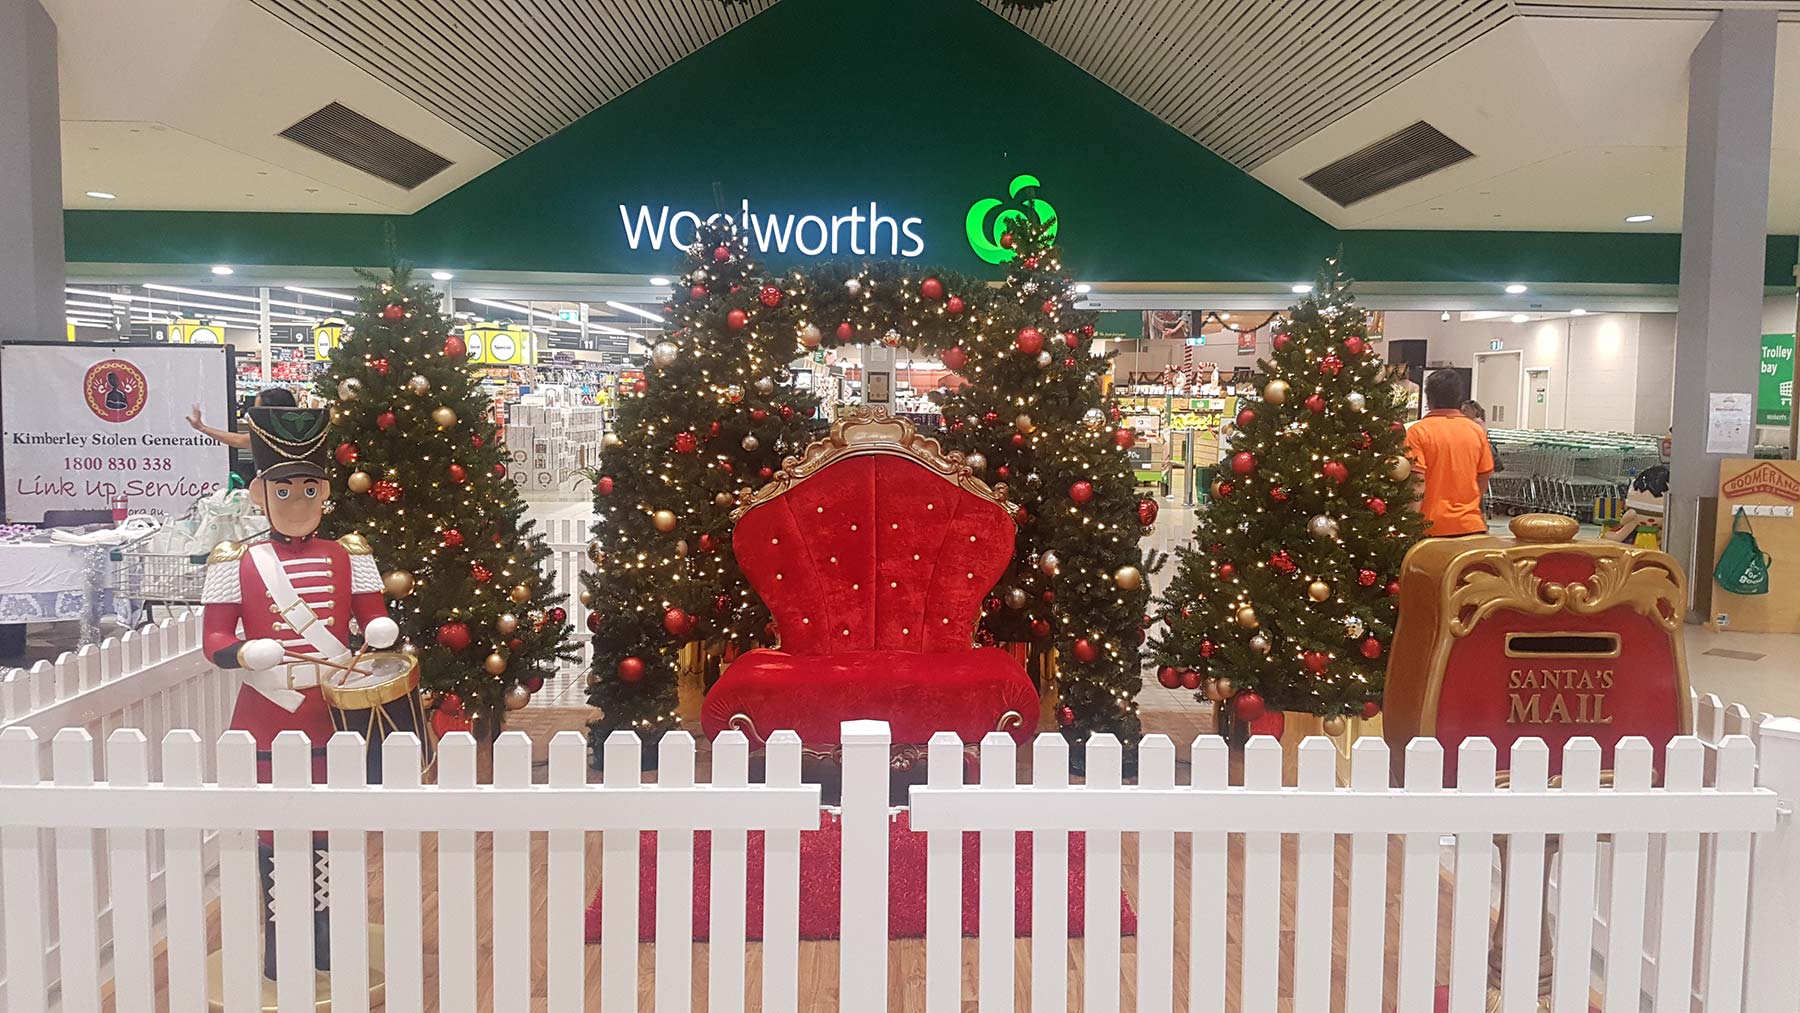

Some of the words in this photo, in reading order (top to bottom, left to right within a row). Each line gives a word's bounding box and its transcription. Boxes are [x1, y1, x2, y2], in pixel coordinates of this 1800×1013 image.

[155, 331, 164, 340] 8
[295, 332, 304, 342] 9
[583, 340, 594, 350] 11
[1761, 345, 1793, 361] Trolley
[1760, 361, 1778, 376] bay
[12, 432, 88, 448] Kimberley
[91, 432, 137, 446] Stolen
[141, 433, 222, 446] Generation
[64, 457, 103, 471] 1800
[107, 457, 137, 471] 830
[142, 457, 172, 471] 338
[1730, 466, 1799, 492] BOOMERANG
[17, 475, 77, 497] Link
[86, 480, 117, 504] Up
[1508, 669, 1614, 689] SANTA'S
[1506, 692, 1614, 723] MAIL
